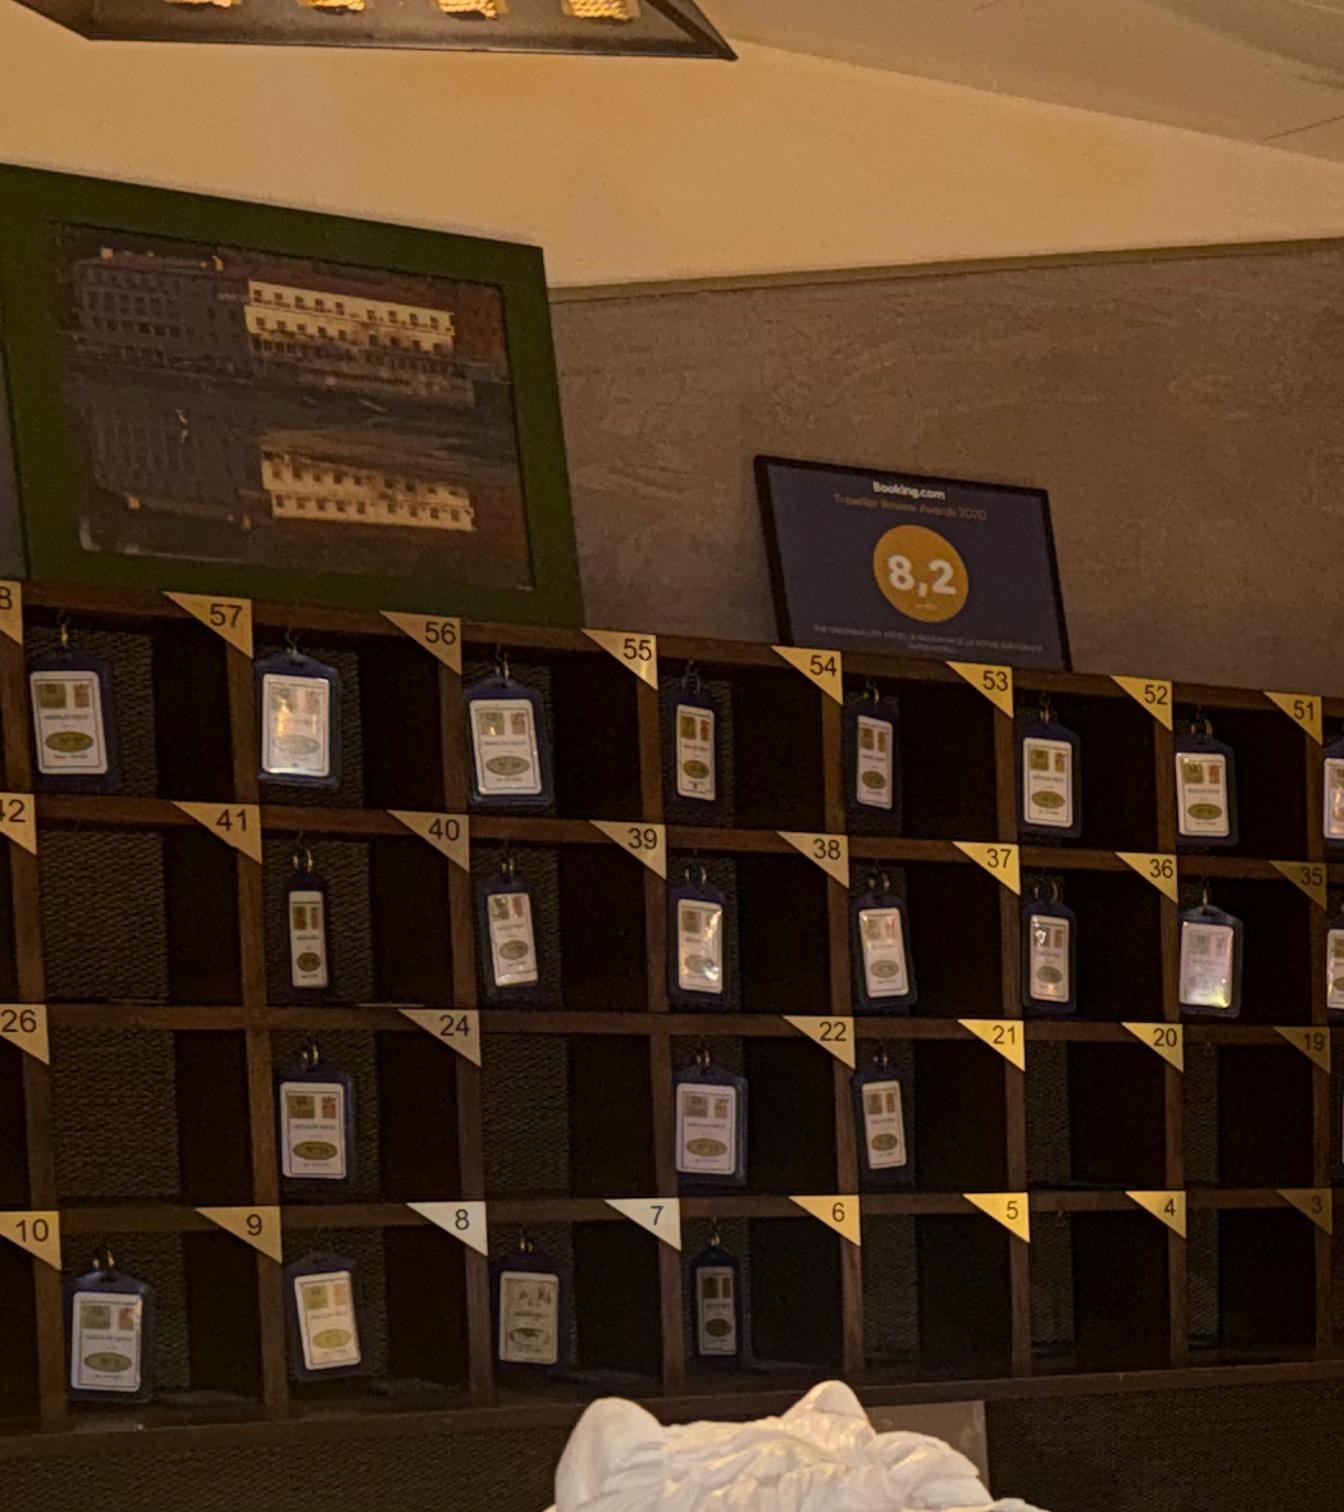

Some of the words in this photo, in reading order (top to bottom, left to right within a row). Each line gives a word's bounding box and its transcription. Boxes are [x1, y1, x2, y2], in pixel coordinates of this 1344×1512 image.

[873, 481, 946, 500] Booking.com
[886, 554, 958, 599] 8,2
[209, 604, 243, 627] 57
[424, 622, 457, 645] 56
[623, 640, 653, 662] 55
[809, 655, 838, 677] 54
[982, 670, 1009, 692] 53
[1144, 685, 1169, 706] 52
[1293, 700, 1316, 721] 51
[0, 799, 26, 824] 2
[216, 809, 248, 832] 41
[429, 820, 461, 842] 40
[628, 828, 658, 851] 39
[813, 839, 841, 861] 38
[986, 848, 1012, 870] 37
[1149, 858, 1174, 879] 36
[1299, 866, 1323, 887] 35
[2, 1009, 38, 1034] 26
[439, 1015, 471, 1037] 24
[819, 1022, 848, 1043] 22
[992, 1026, 1018, 1046] 21
[1154, 1028, 1178, 1049] 20
[1303, 1033, 1325, 1053] 19
[650, 1205, 665, 1227] 7
[831, 1202, 846, 1223] 6
[1006, 1200, 1020, 1221] 5
[1163, 1197, 1177, 1217] 4
[1311, 1196, 1324, 1216] 3
[15, 1220, 50, 1243] 10
[246, 1213, 263, 1237] 9
[454, 1209, 470, 1232] 8
